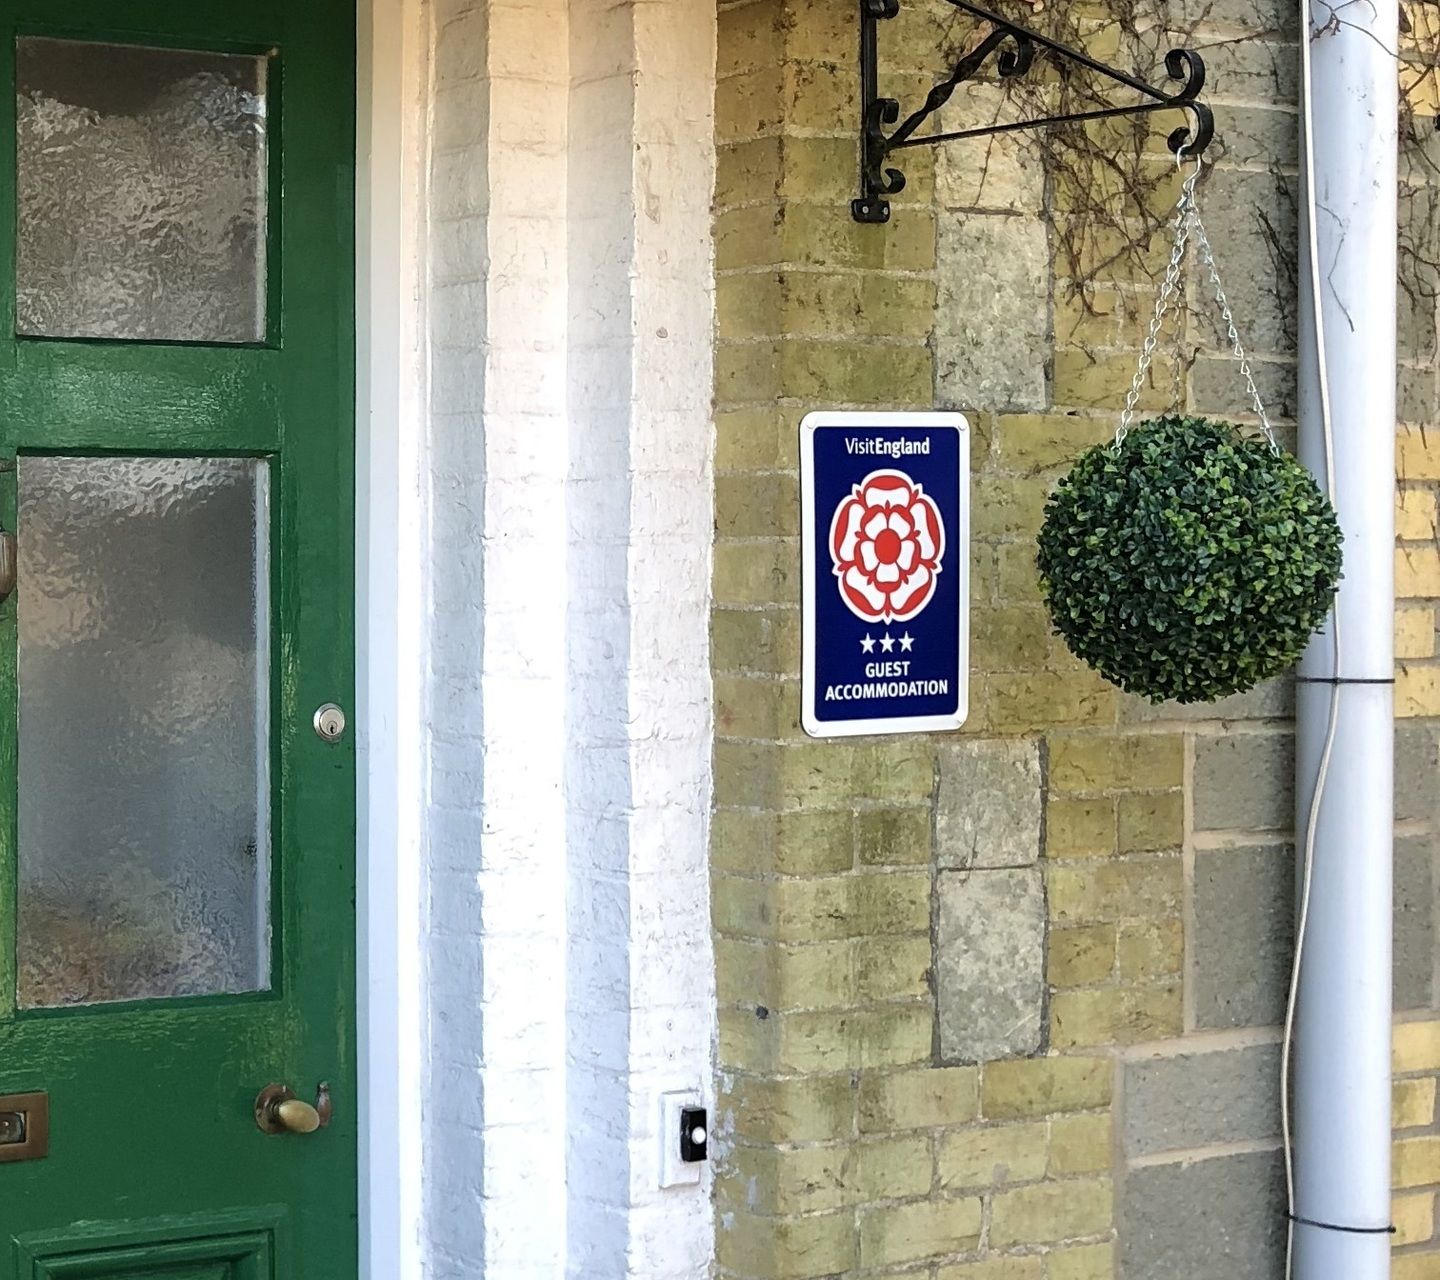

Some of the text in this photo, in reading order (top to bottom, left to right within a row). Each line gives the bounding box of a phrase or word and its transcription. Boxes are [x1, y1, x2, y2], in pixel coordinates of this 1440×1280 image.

[845, 437, 930, 458] VisitEngland
[865, 661, 911, 678] GUEST
[825, 679, 948, 701] ACCOMMODATION
